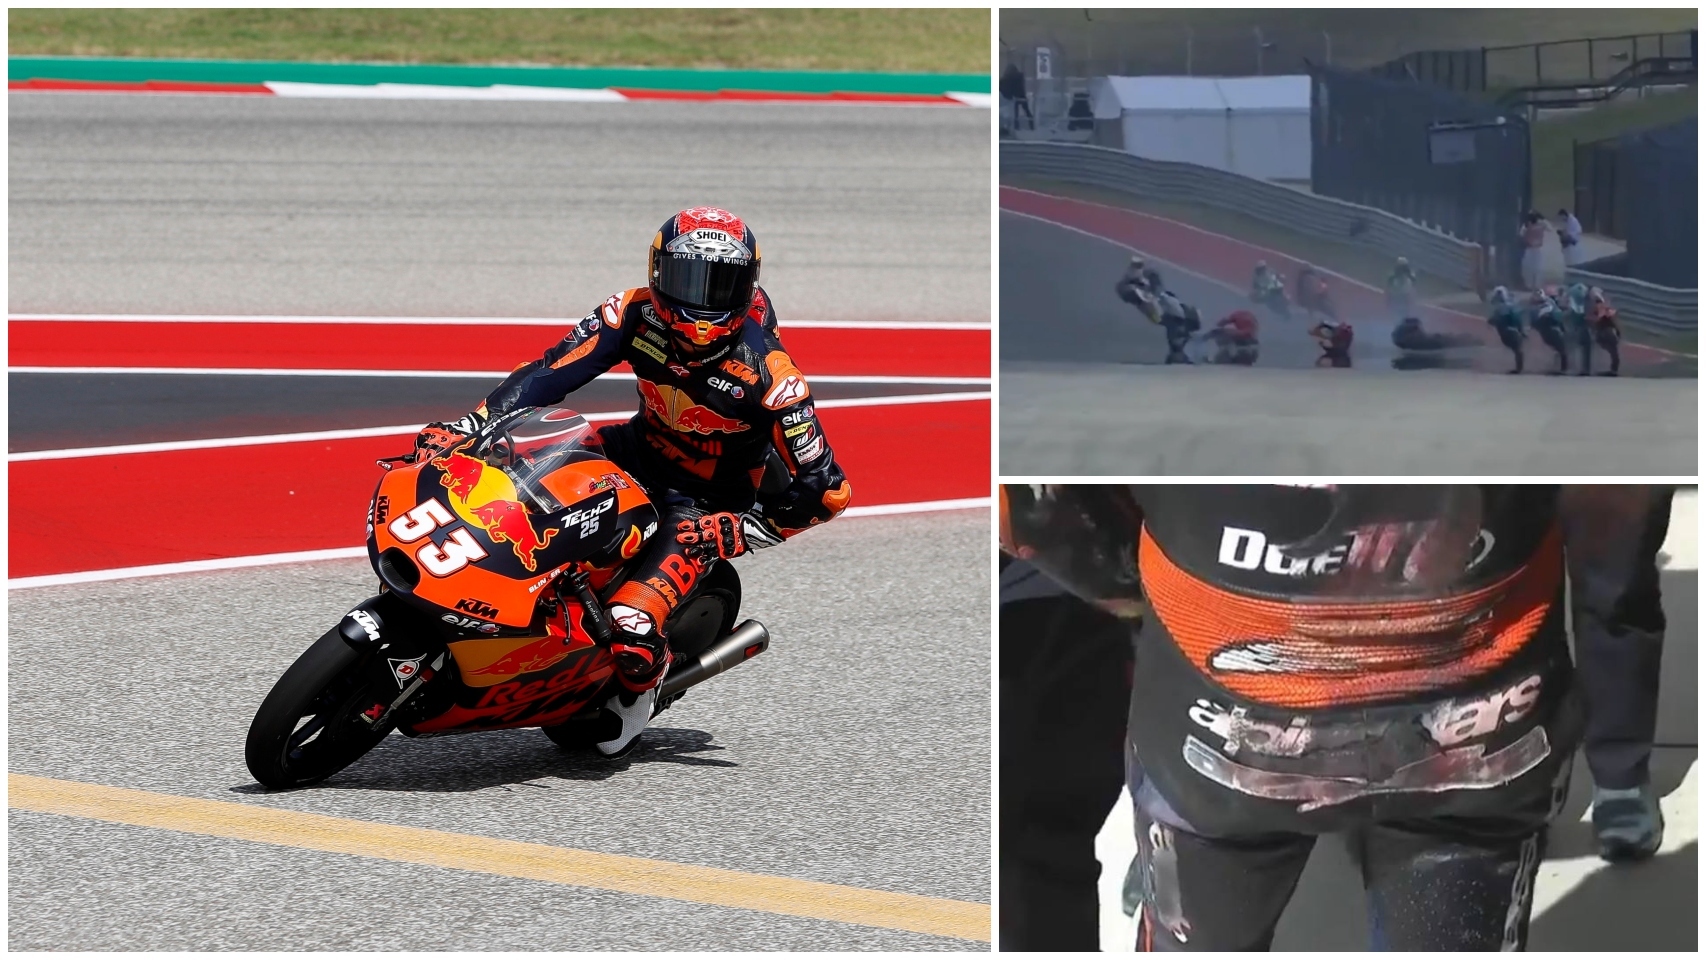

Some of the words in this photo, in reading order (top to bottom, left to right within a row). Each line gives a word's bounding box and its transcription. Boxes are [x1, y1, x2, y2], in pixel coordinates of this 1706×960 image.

[696, 231, 727, 242] SHOEI
[673, 253, 696, 261] GIVES
[701, 255, 719, 263] YOU
[723, 257, 748, 267] WINGS
[707, 376, 733, 392] elf
[719, 359, 761, 386] KTM
[782, 410, 803, 426] elf
[376, 495, 390, 525] KTM
[560, 497, 614, 529] TECH3
[387, 496, 490, 578] 53
[579, 516, 600, 539] 25
[643, 521, 658, 542] KTM
[646, 577, 678, 608] KTM
[454, 598, 500, 620] KTM
[347, 609, 381, 641] KTM
[441, 613, 483, 630] elf
[476, 653, 590, 708] Red
